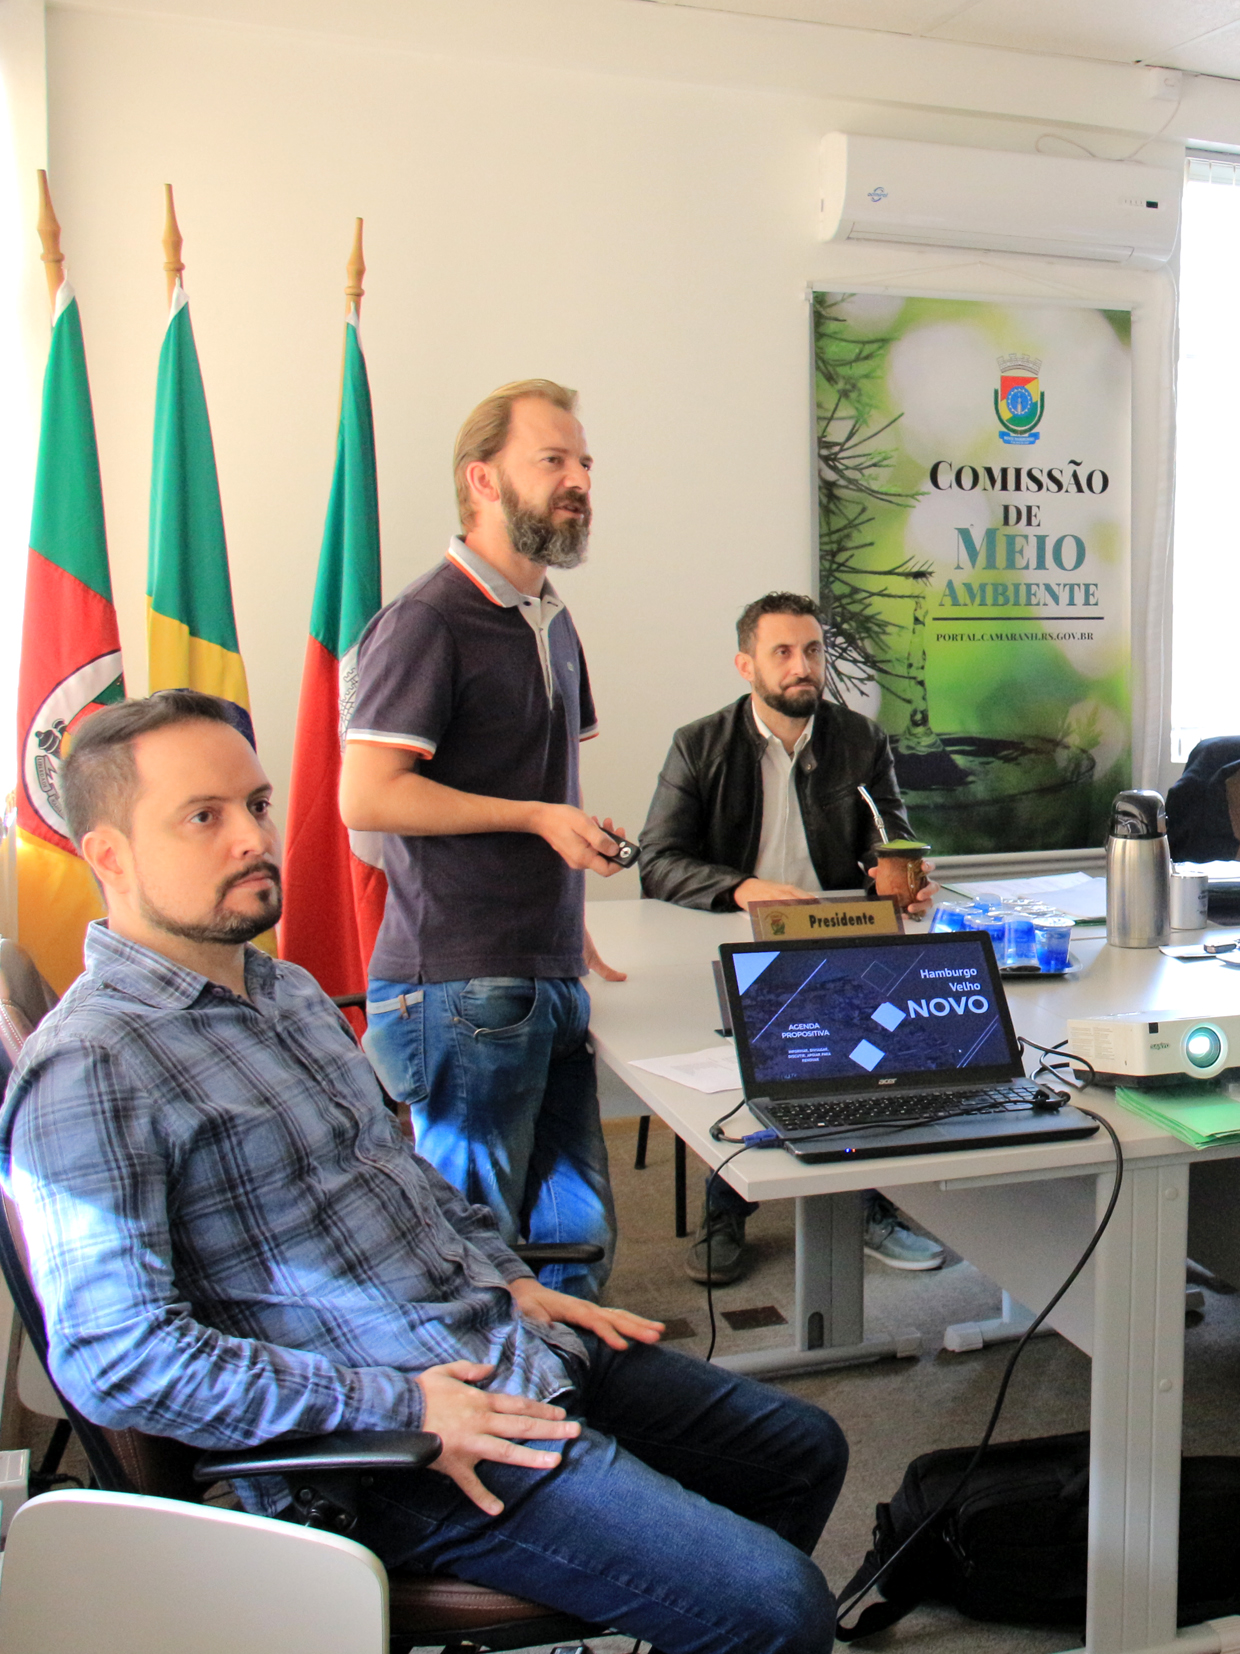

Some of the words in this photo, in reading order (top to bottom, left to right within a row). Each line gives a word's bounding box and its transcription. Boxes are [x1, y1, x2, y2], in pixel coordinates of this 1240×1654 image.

[929, 459, 1110, 495] COMISSÃO
[1001, 504, 1042, 528] DE
[954, 527, 1086, 572] MEIO
[938, 578, 1099, 607] AMBIENTE
[808, 911, 875, 929] Presidente
[919, 968, 978, 979] Hamburgo
[948, 982, 981, 992] Velho
[907, 994, 989, 1018] NOVO
[781, 1029, 831, 1039] PROPOSITIVA
[788, 1022, 820, 1031] AGENDA
